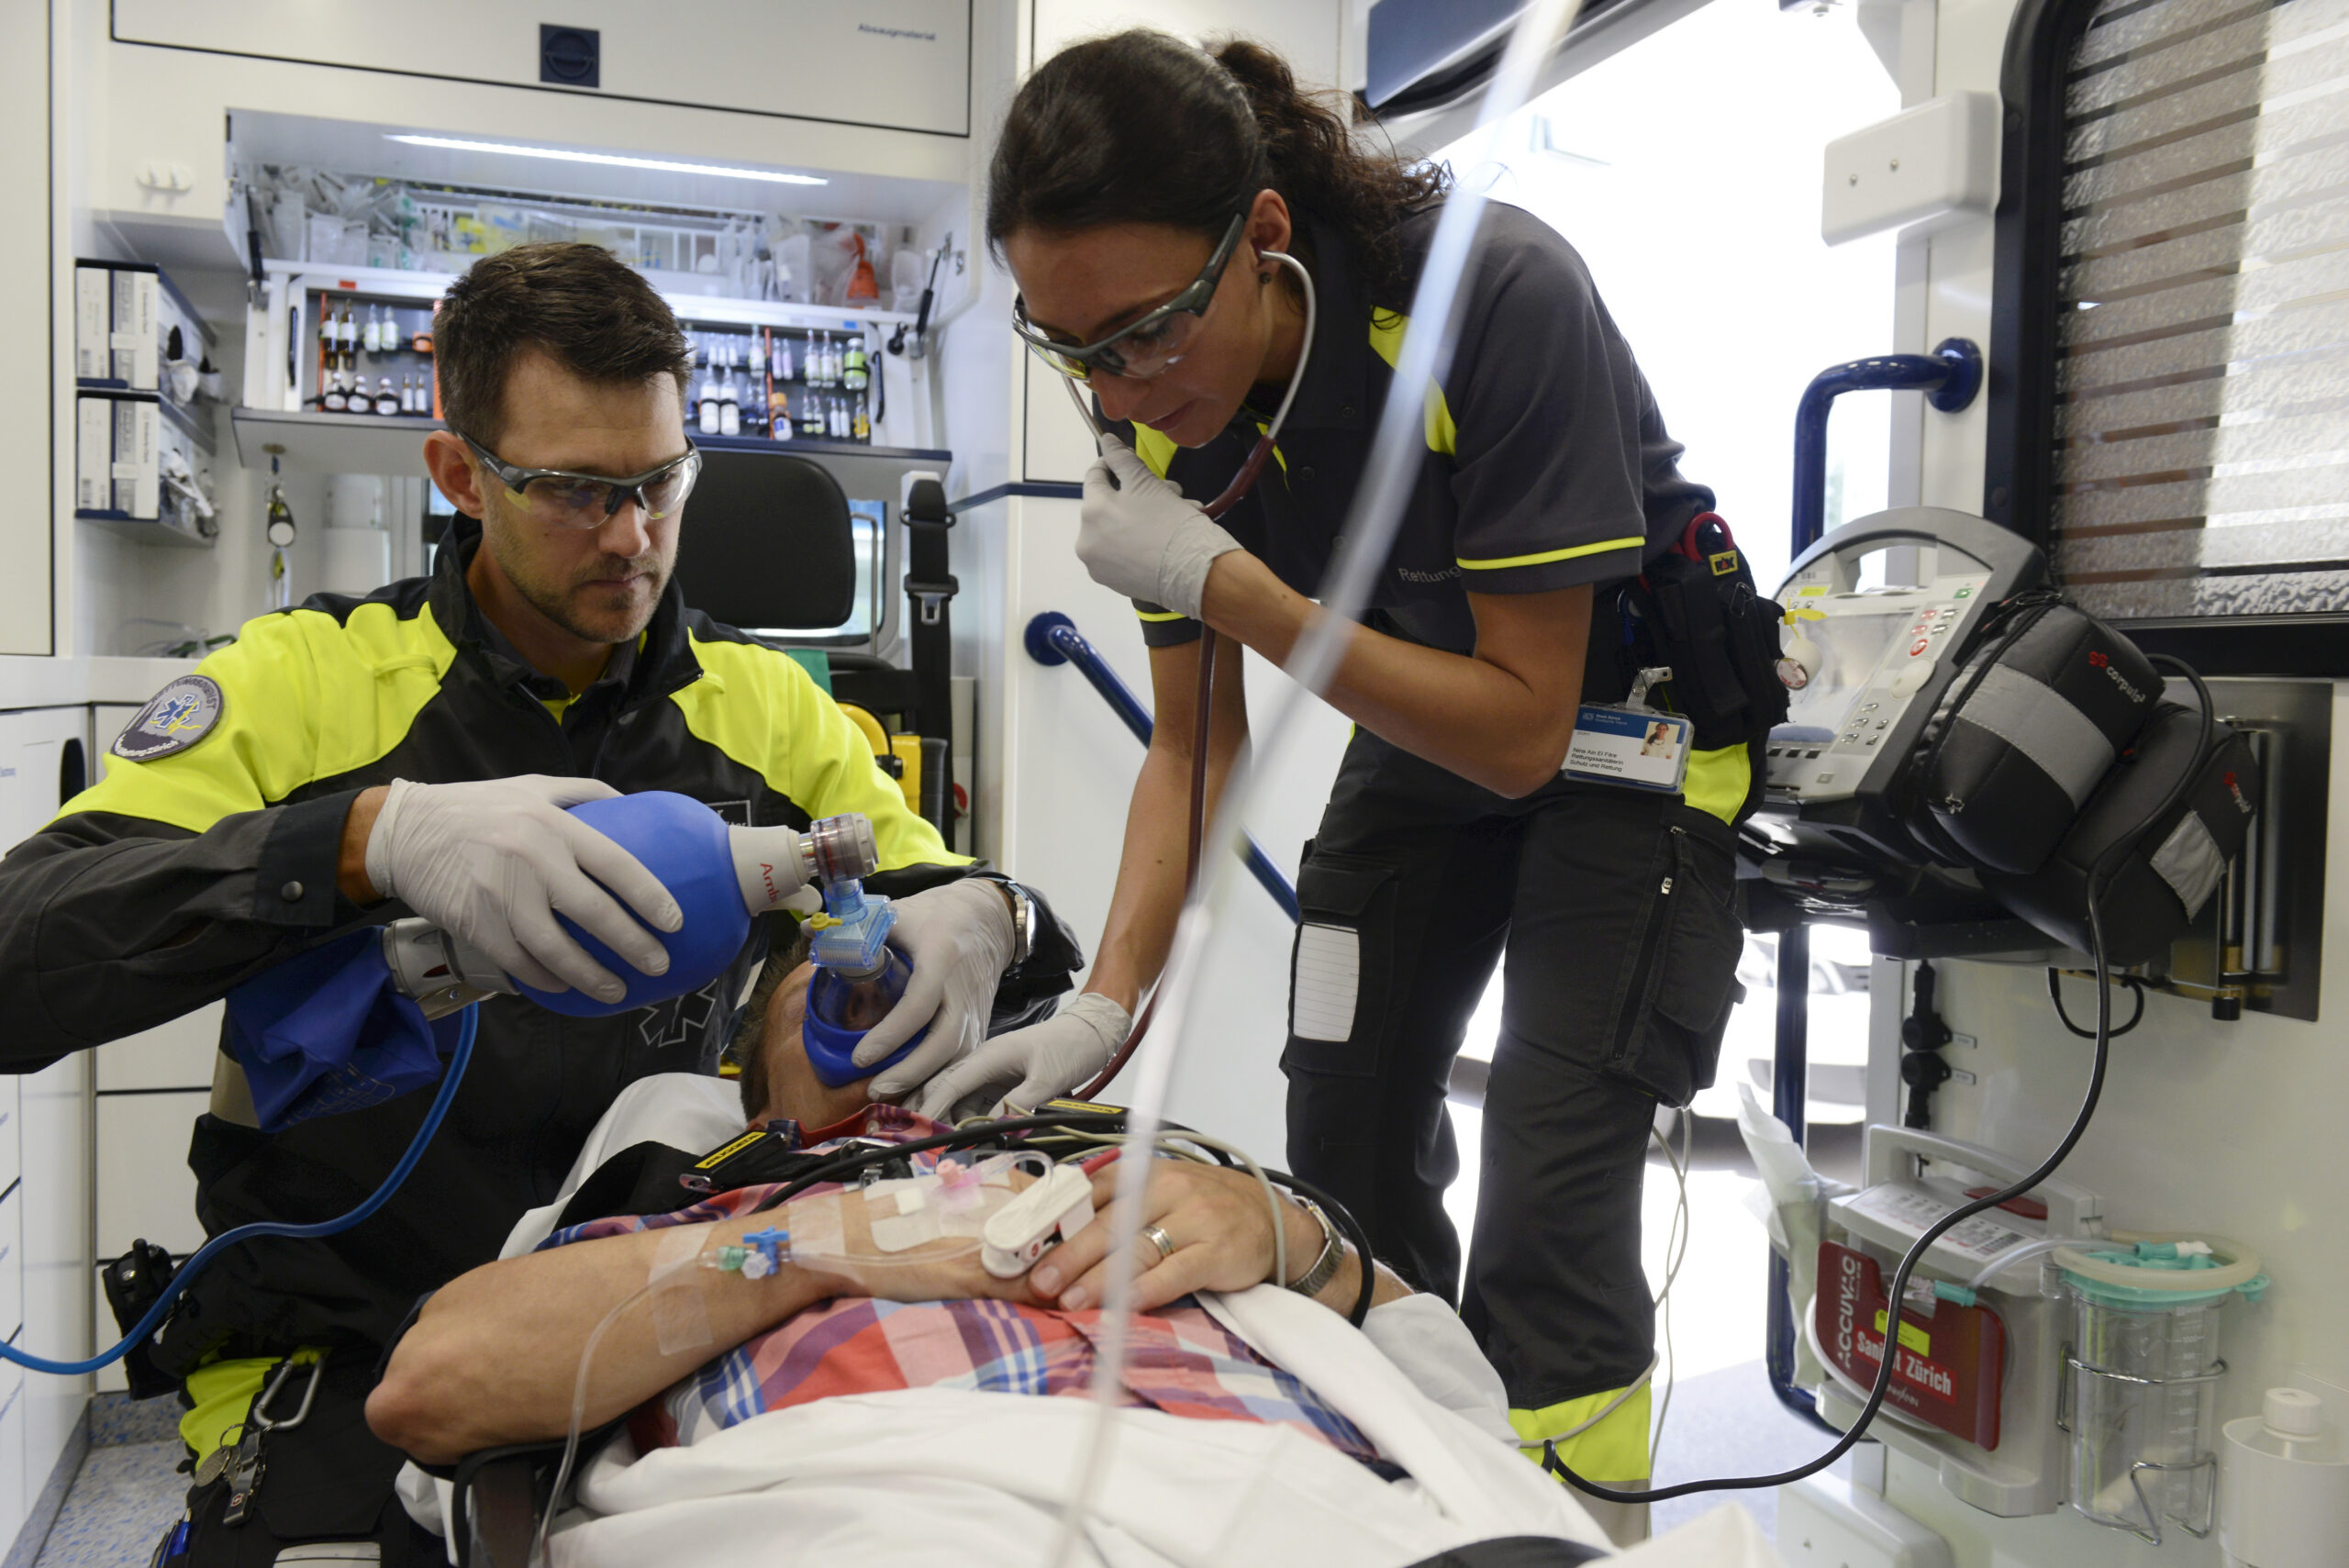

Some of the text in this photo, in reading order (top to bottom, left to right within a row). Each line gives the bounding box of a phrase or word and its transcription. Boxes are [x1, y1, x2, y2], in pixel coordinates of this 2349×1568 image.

[1837, 1255, 1856, 1369] ACCUVAC
[1857, 1330, 1901, 1373] Sanit
[1906, 1355, 1952, 1396] Zürich
